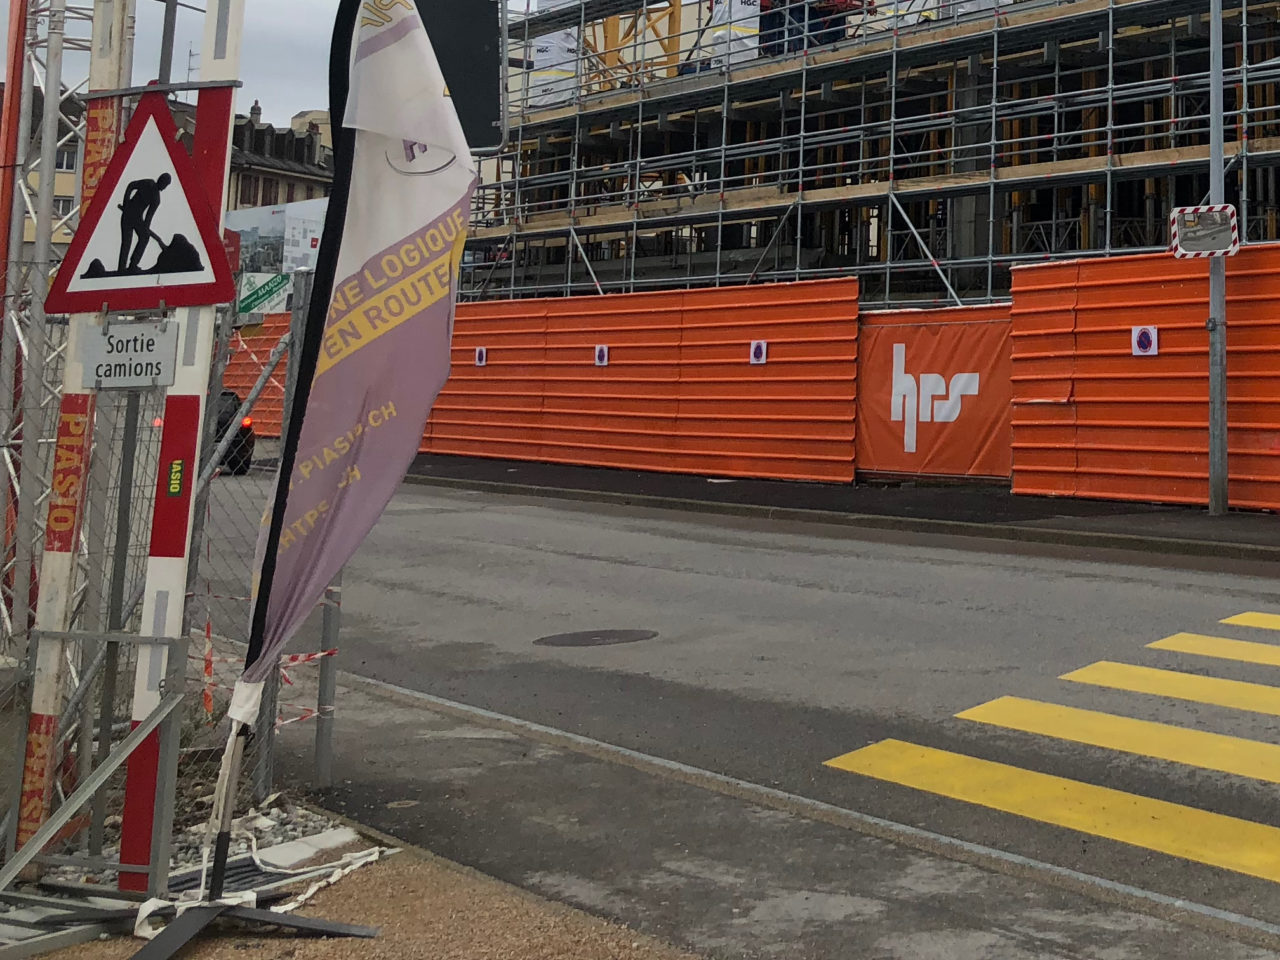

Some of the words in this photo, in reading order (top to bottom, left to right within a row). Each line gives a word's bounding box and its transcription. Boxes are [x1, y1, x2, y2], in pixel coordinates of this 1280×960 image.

[740, 0, 758, 7] HGC
[330, 280, 364, 320] NE
[364, 207, 465, 290] LOGIQUE
[106, 333, 155, 354] Sortie
[323, 321, 362, 360] EN
[363, 262, 450, 331] ROUTE
[95, 357, 162, 378] camions
[891, 343, 979, 453] hrs
[50, 413, 87, 531] PIASIO
[170, 460, 183, 493] IASIO
